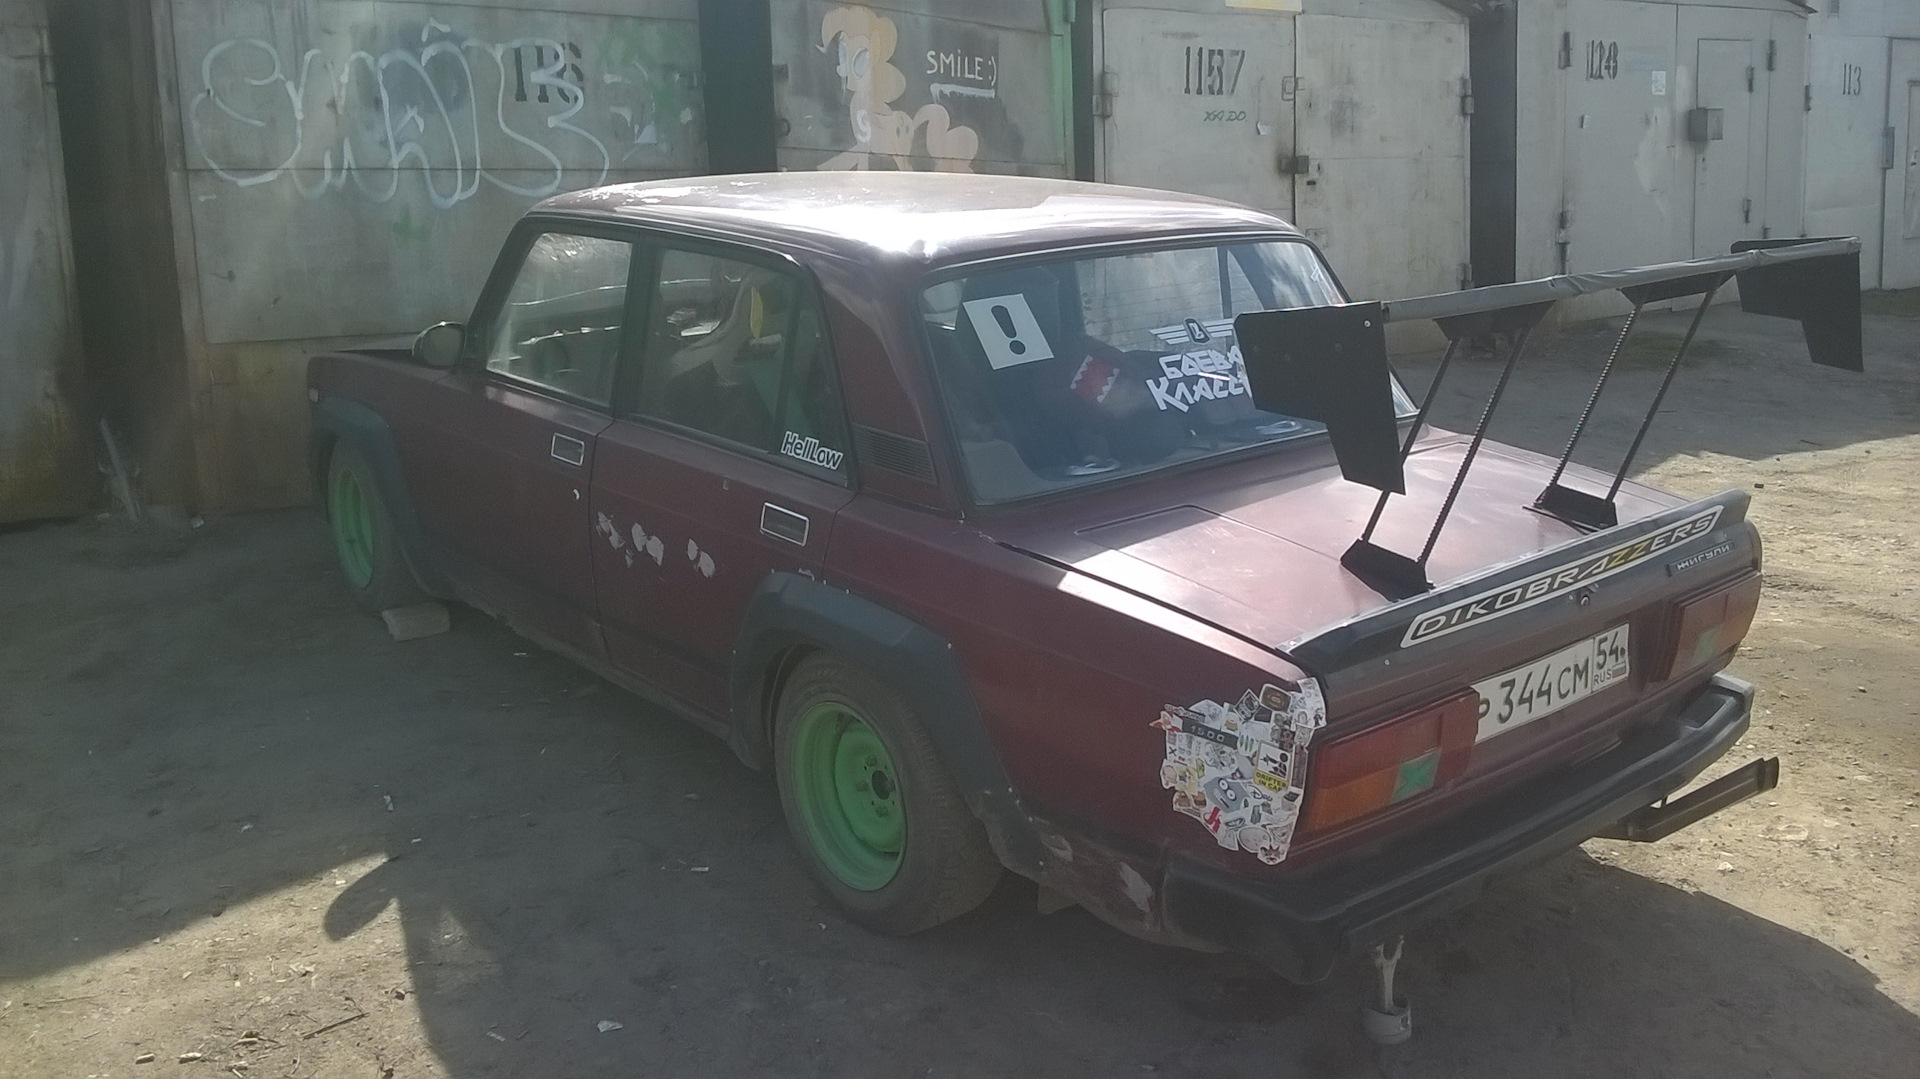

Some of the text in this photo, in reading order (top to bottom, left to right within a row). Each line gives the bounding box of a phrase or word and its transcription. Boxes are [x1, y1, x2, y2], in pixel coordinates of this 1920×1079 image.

[1842, 63, 1862, 96] 113
[1158, 346, 1245, 378] БОЕВА
[1411, 512, 1714, 637] DIKOBRAZZERS
[1596, 631, 1619, 669] 54
[1593, 670, 1612, 686] RUS
